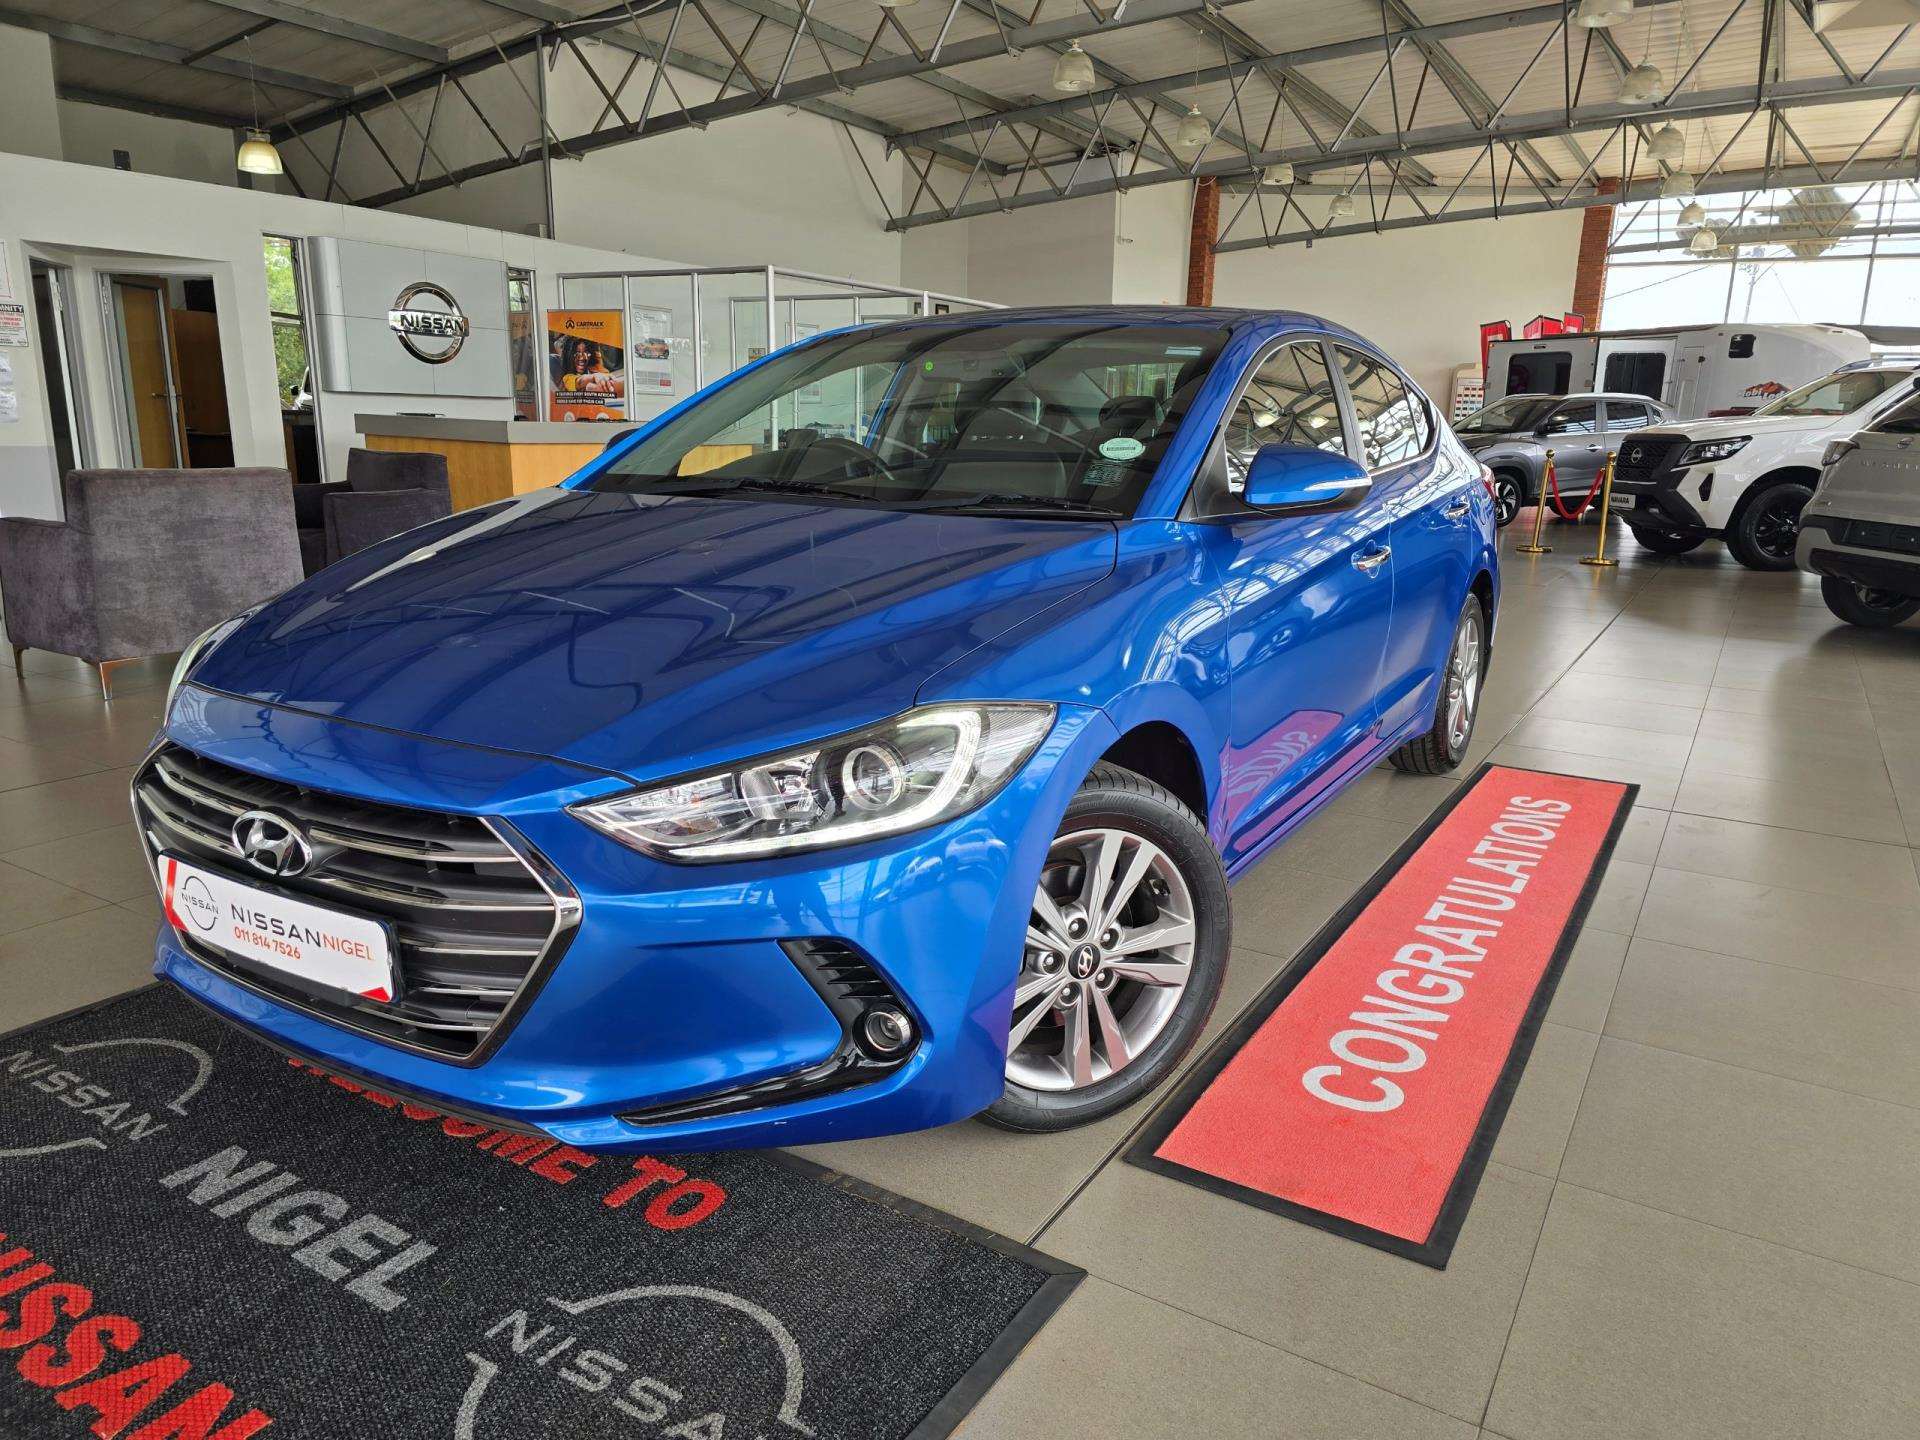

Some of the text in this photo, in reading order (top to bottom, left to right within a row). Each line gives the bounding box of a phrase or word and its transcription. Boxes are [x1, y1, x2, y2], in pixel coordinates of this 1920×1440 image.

[400, 315, 464, 333] NISSAN
[181, 892, 220, 915] NISSAN
[234, 926, 301, 961] 011 814 7526
[1301, 795, 1572, 1113] CONGRATULATIONS
[0, 1050, 169, 1141] NISSAN
[158, 1145, 437, 1312] NIGEL
[603, 1155, 728, 1231] TO
[484, 1309, 727, 1440] NISSA
